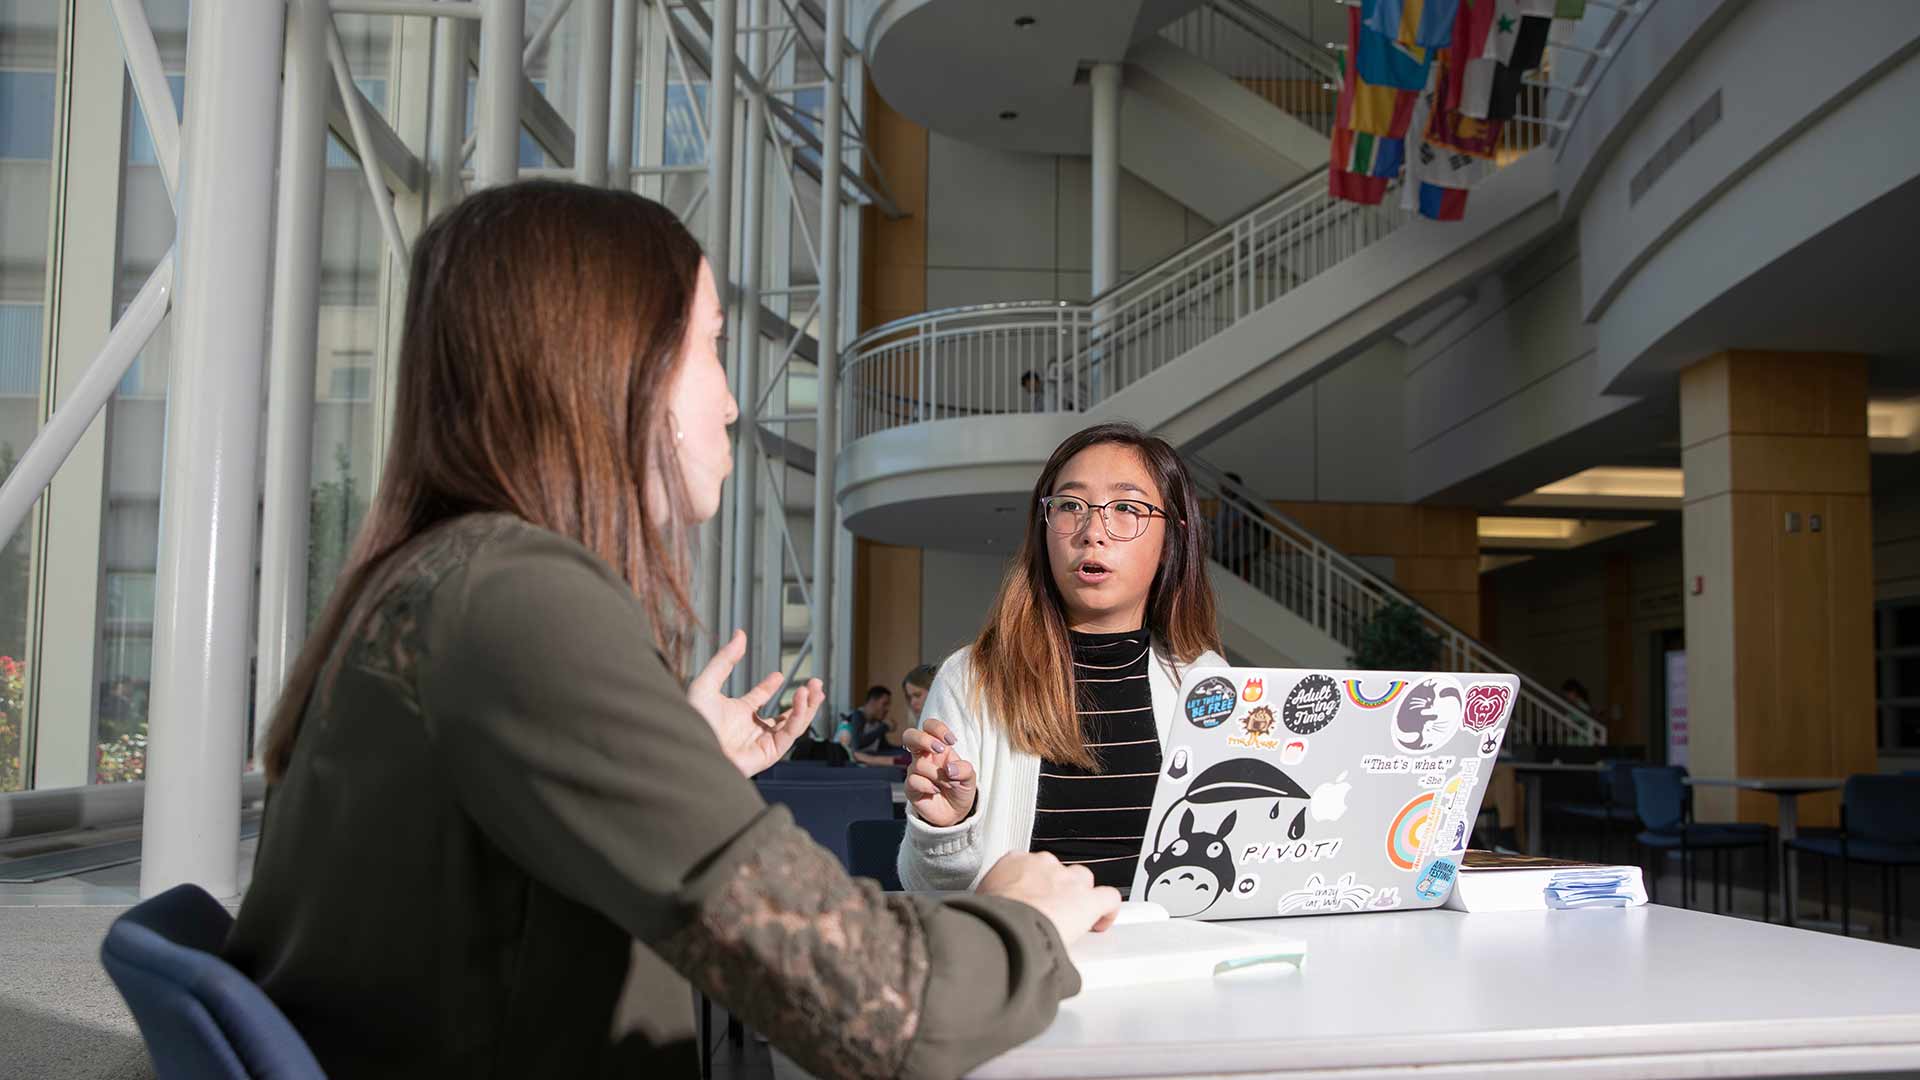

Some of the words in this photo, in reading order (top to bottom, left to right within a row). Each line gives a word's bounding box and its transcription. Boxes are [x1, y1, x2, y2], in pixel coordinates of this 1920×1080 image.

[1291, 685, 1332, 705] Adult
[1187, 699, 1200, 709] LET
[1191, 705, 1206, 718] BE
[1207, 698, 1234, 715] FREE
[1315, 699, 1337, 716] ing
[1294, 711, 1326, 726] Time
[1432, 860, 1456, 874] ANIMAL
[1429, 868, 1452, 882] TESTING
